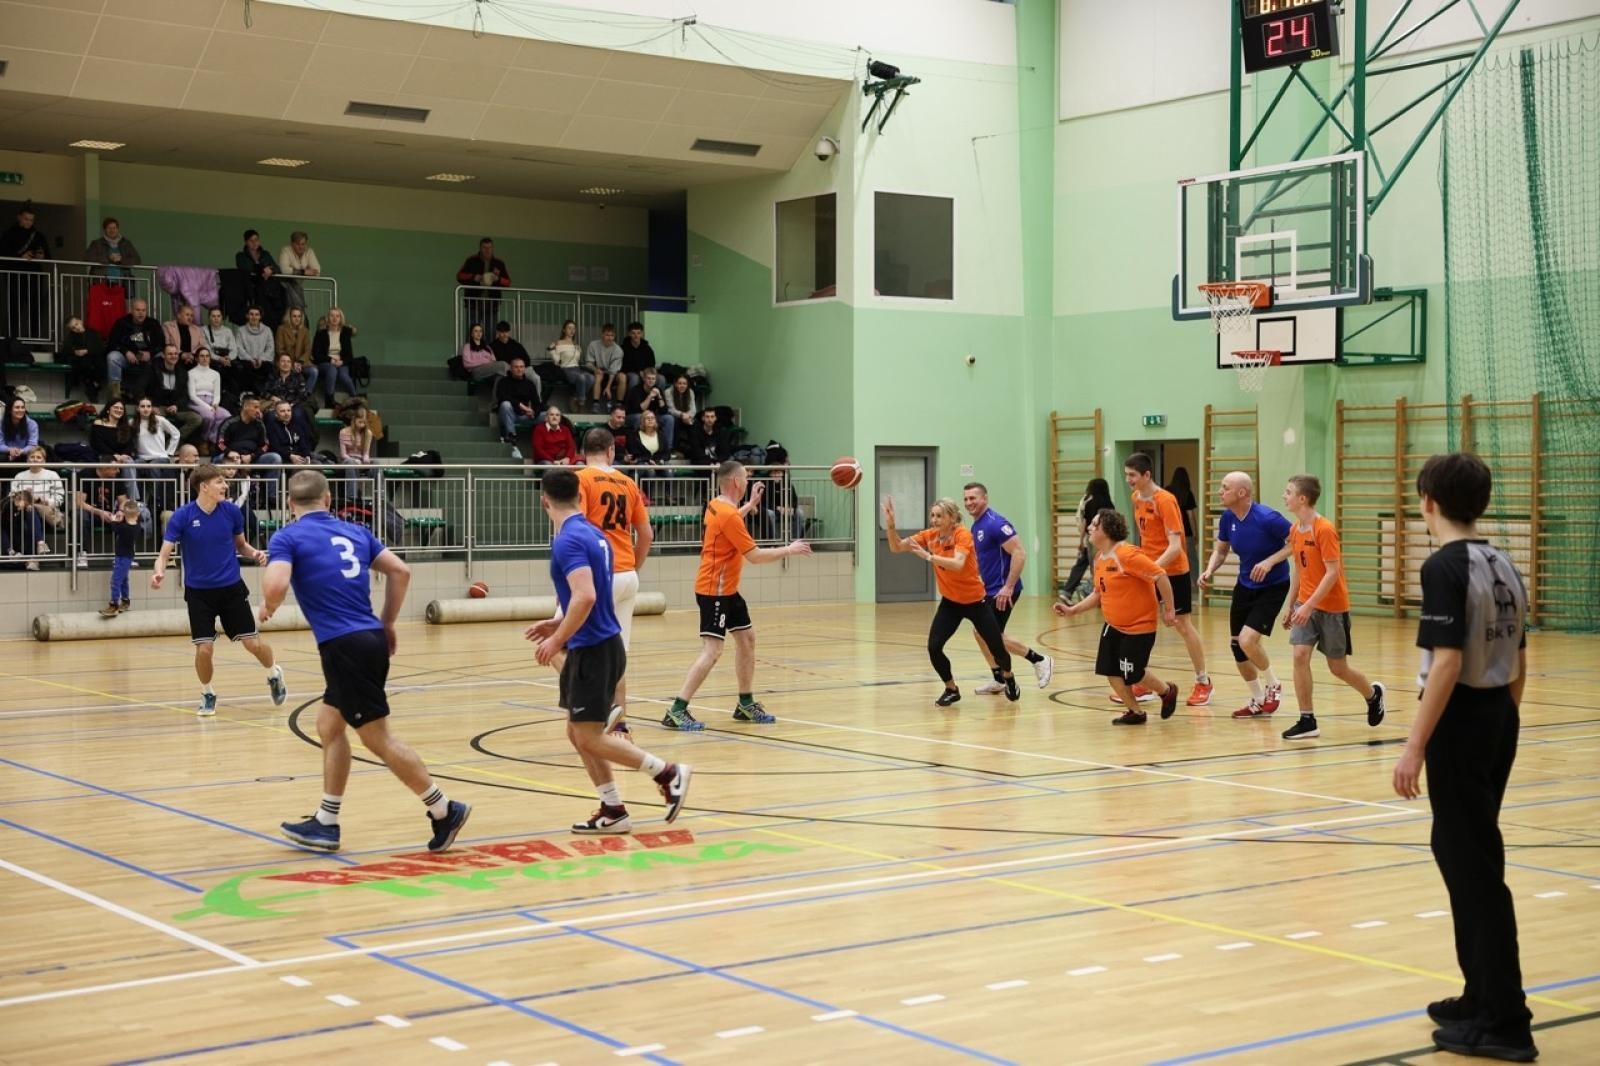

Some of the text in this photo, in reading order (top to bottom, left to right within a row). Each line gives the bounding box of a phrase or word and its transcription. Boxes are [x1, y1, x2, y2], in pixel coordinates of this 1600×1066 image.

[1267, 16, 1309, 55] 24
[330, 536, 360, 578] 3
[719, 613, 726, 628] 8
